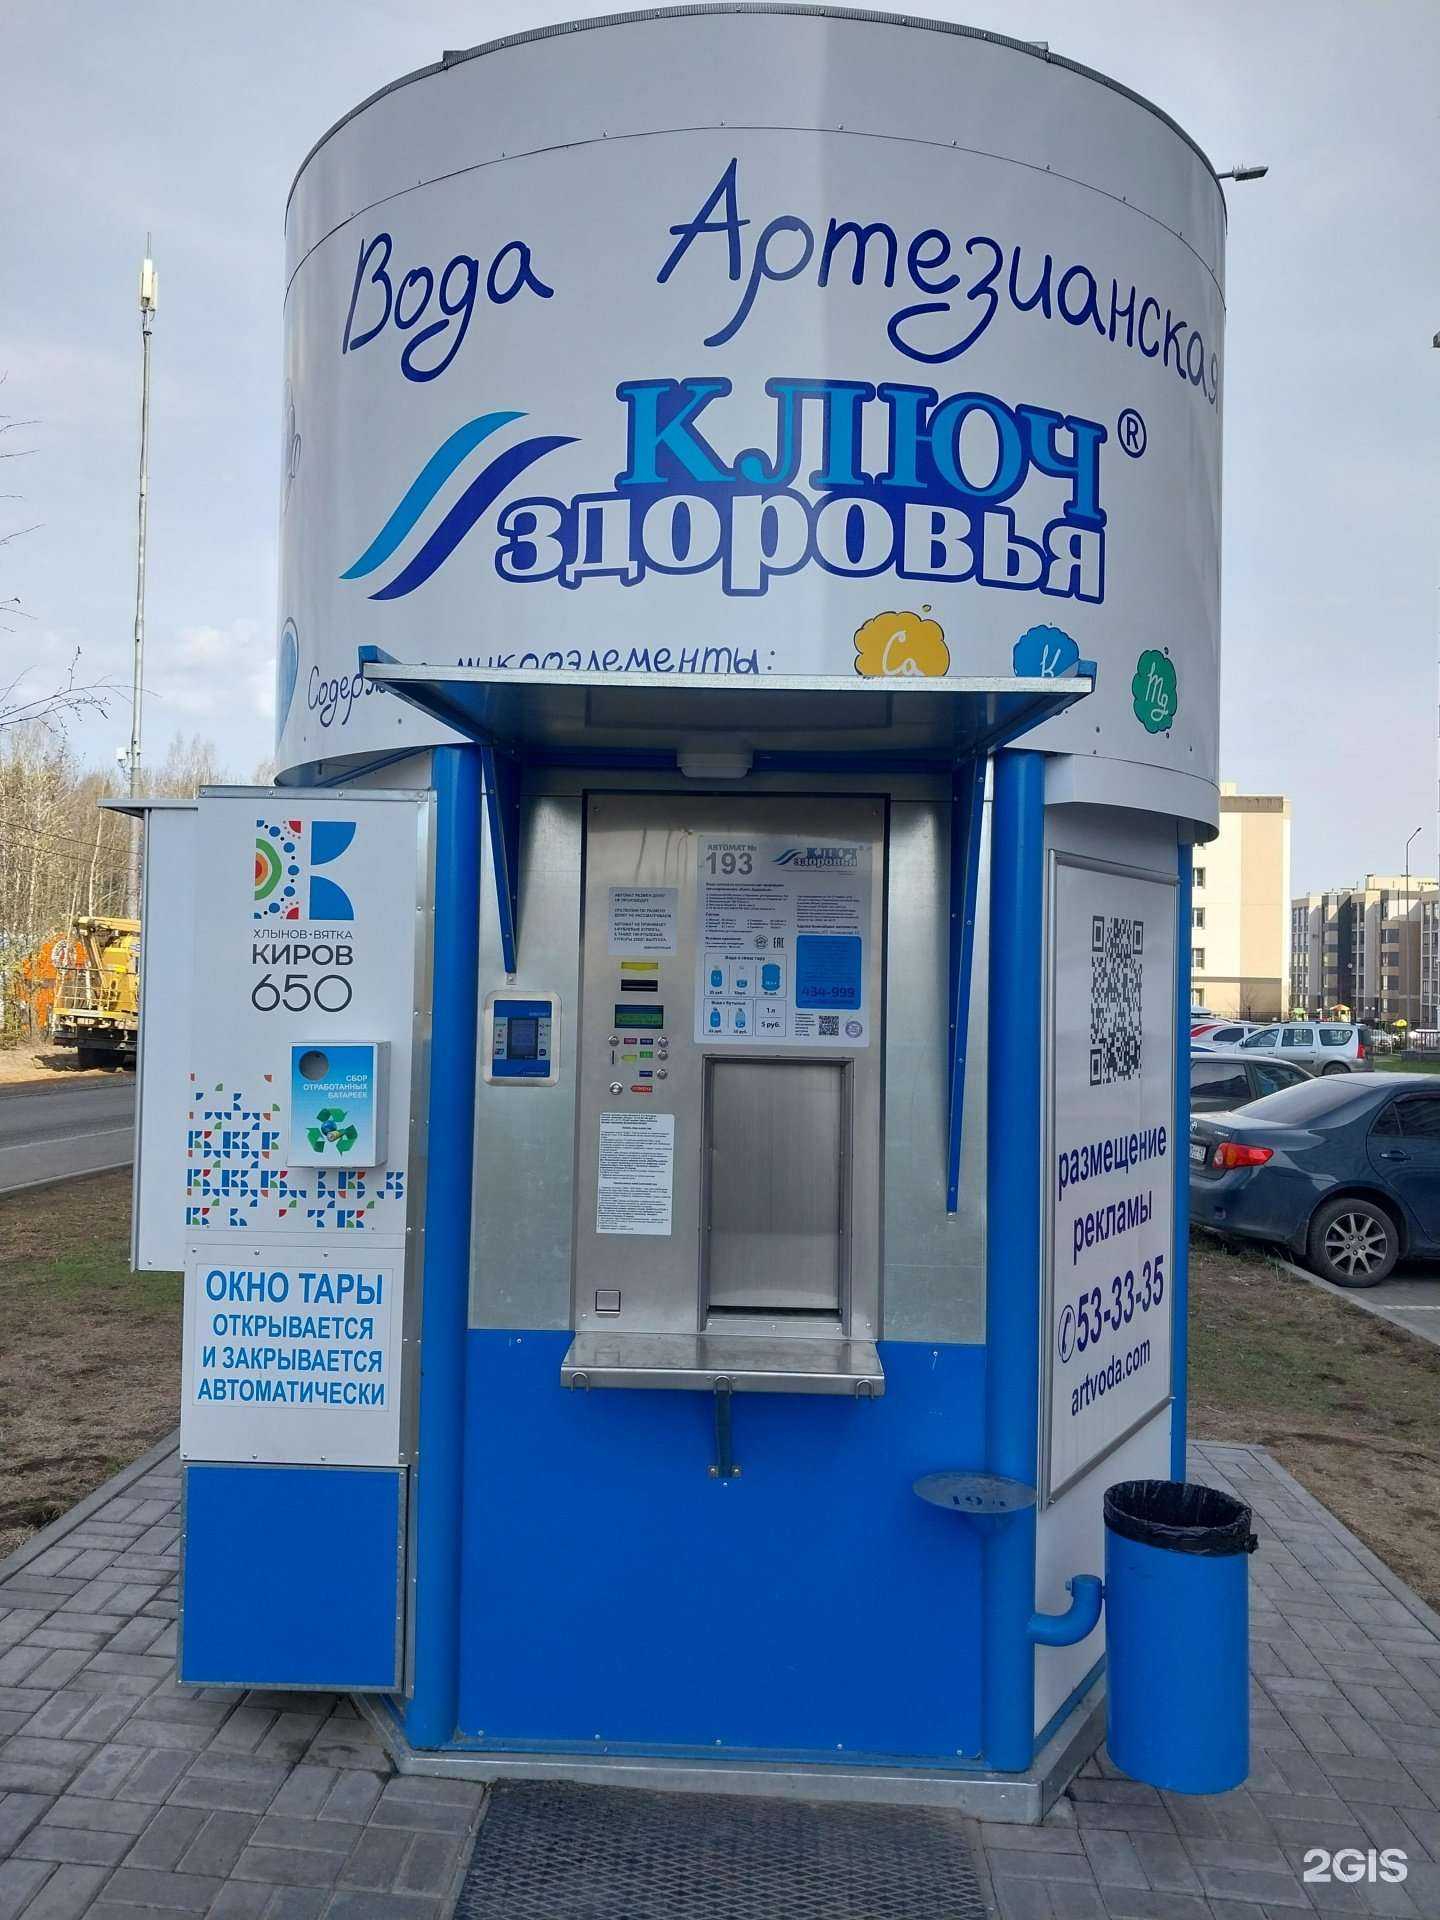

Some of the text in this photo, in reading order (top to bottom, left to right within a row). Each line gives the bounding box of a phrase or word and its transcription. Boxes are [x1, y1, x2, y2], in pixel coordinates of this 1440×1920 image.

[343, 233, 554, 382] Вода
[615, 376, 1109, 527] КЛЮЧ
[707, 844, 749, 852] АВТОМАТ
[706, 852, 753, 875] 193
[252, 944, 354, 966] КИРОВ
[251, 973, 353, 1013] 650
[303, 1083, 368, 1092] ОТРАБОТАННЫХ
[345, 1074, 368, 1082] СБОР
[327, 1092, 368, 1100] БАТАРЕЕК
[1058, 1125, 1167, 1202] размещение
[1073, 1189, 1153, 1266] рекламы
[206, 1270, 383, 1305] ОКНО ТАРЫ
[1076, 1253, 1165, 1353] 53-33-35
[212, 1313, 374, 1340] ОТКРЫВАЕТСЯ
[202, 1345, 383, 1373] И ЗАКРЫВАЕТСЯ
[197, 1378, 385, 1406] АВТОМАТИЧЕСКИ
[1071, 1338, 1151, 1418] artvoda.com
